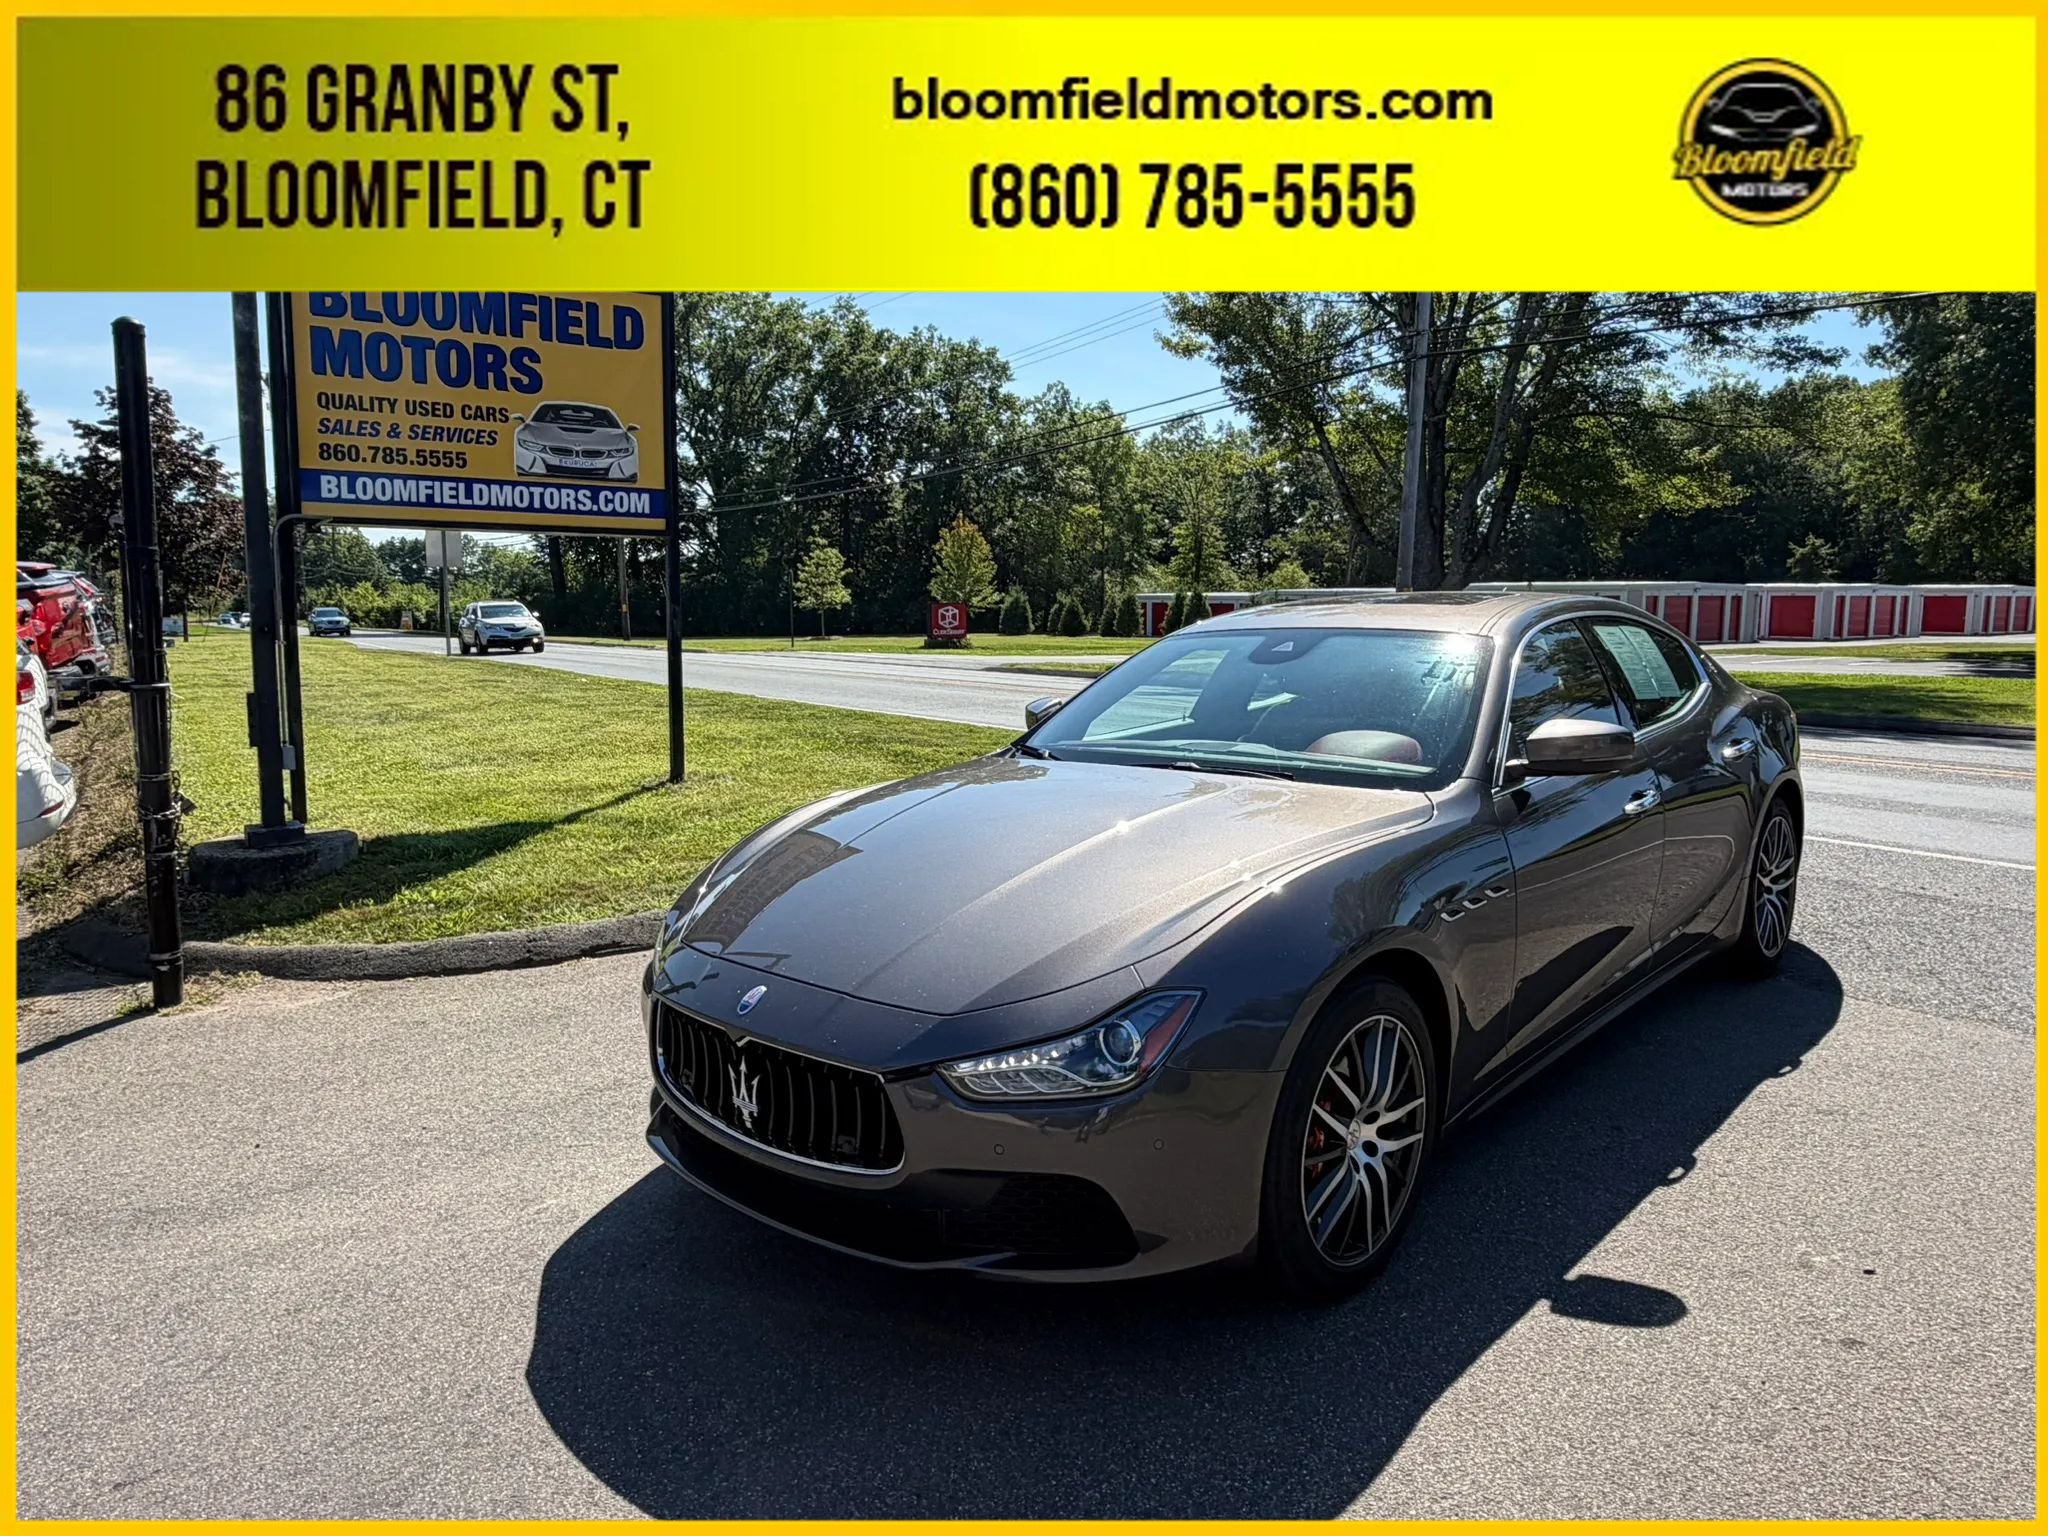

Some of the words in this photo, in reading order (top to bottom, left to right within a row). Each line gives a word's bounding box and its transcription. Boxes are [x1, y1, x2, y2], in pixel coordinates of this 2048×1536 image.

[309, 291, 644, 350] BLOOMFIELD
[309, 325, 543, 395] MOTORS
[317, 392, 399, 414] QUALITY
[405, 400, 455, 419] USED
[461, 404, 510, 423] CARS
[317, 417, 382, 438] SALES
[386, 423, 402, 439] &
[408, 424, 498, 446] SERVICES
[318, 443, 468, 469] 860.785.5555
[320, 475, 650, 515] BLOOMFIELDMOTORS.COM
